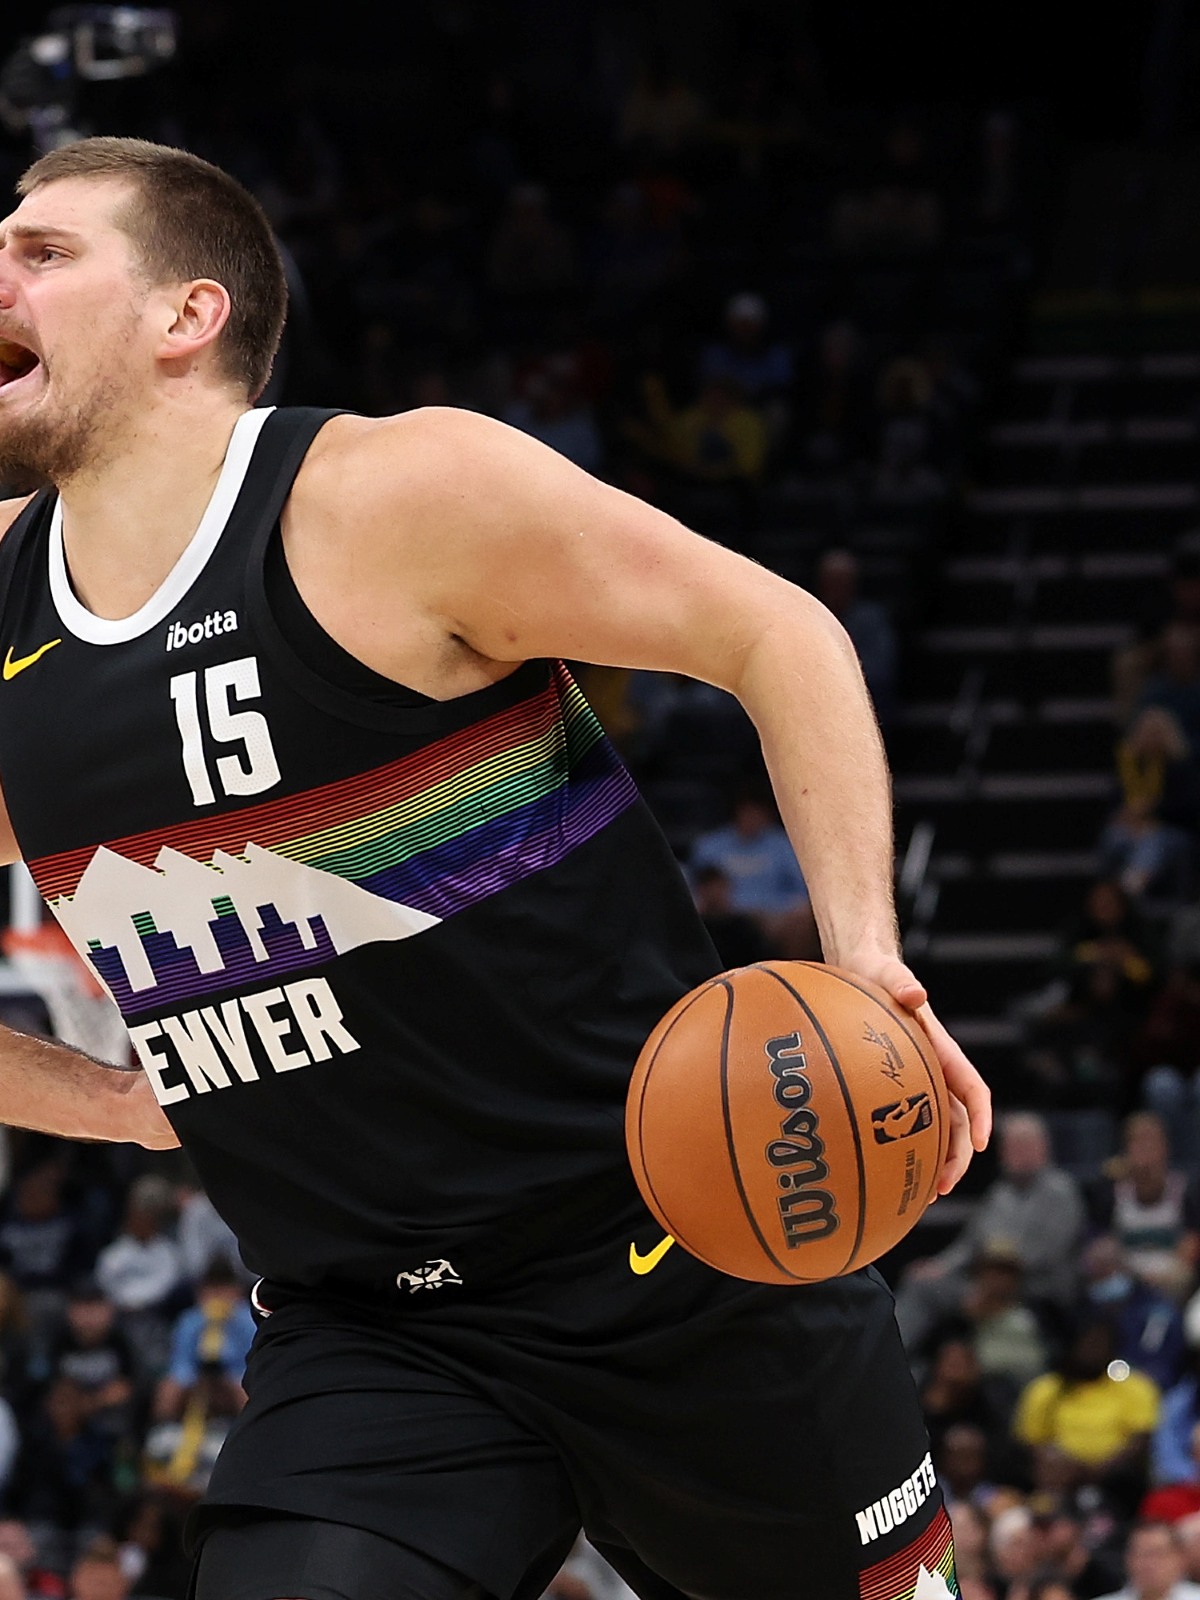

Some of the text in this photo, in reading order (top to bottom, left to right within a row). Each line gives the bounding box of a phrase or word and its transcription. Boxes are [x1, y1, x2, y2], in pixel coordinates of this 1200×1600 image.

[166, 610, 239, 652] ibotta
[170, 656, 282, 806] 15
[127, 977, 361, 1106] ENVER
[764, 1031, 840, 1250] Wilson
[855, 1451, 937, 1546] NUGGETS
